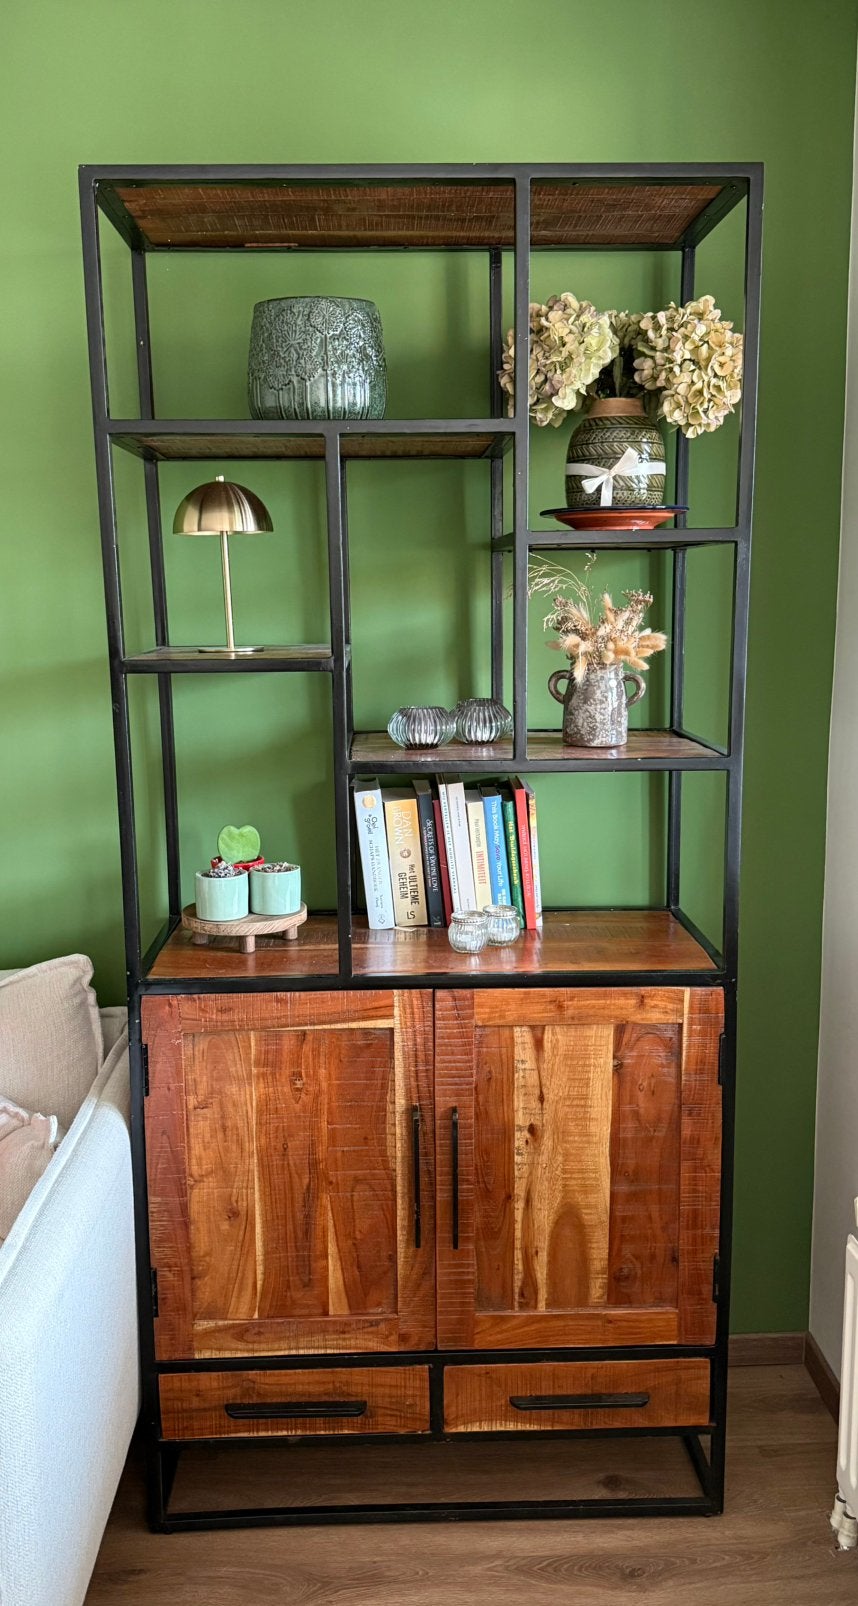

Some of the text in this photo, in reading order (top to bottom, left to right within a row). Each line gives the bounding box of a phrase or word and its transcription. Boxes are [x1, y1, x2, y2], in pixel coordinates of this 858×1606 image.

[392, 807, 405, 845] BROWN
[402, 811, 413, 837] DAN
[397, 872, 409, 899] GEHEIM
[408, 875, 419, 905] ULTIEME
[497, 874, 505, 886] Life
[406, 910, 416, 920] LS
